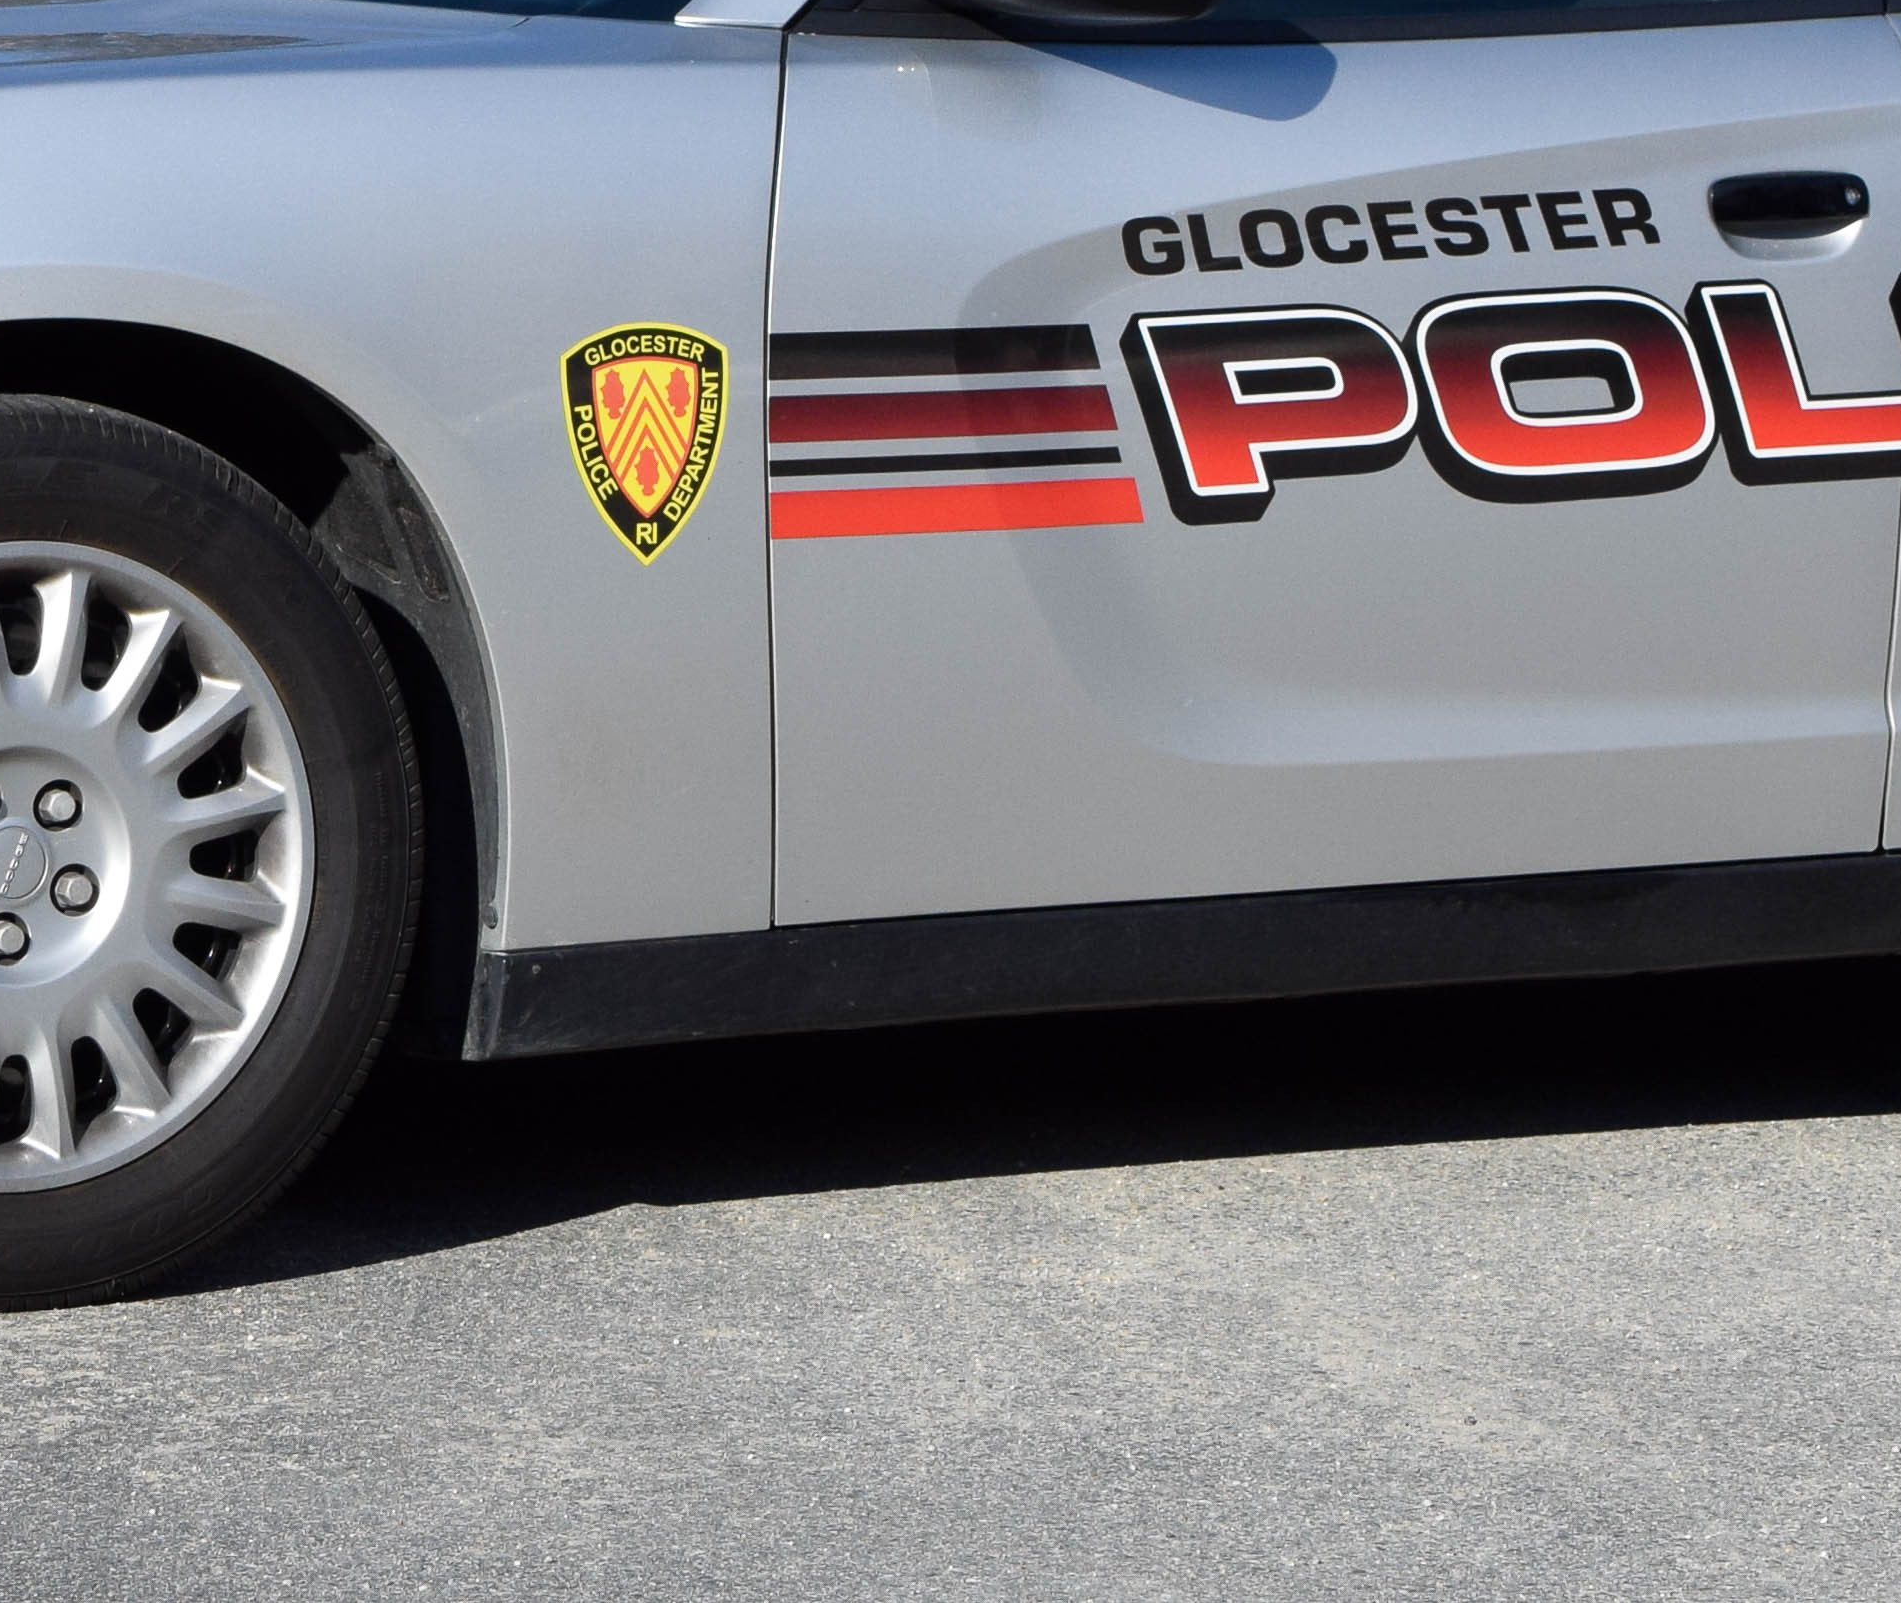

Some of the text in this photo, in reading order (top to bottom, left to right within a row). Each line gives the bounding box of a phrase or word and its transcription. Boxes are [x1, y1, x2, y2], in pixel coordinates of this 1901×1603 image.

[1121, 187, 1661, 276] GLOCESTER
[584, 334, 706, 367] GLOCESTER
[574, 404, 619, 501] POLICE
[663, 367, 719, 522] DEPARTMENT
[636, 522, 658, 545] RI
